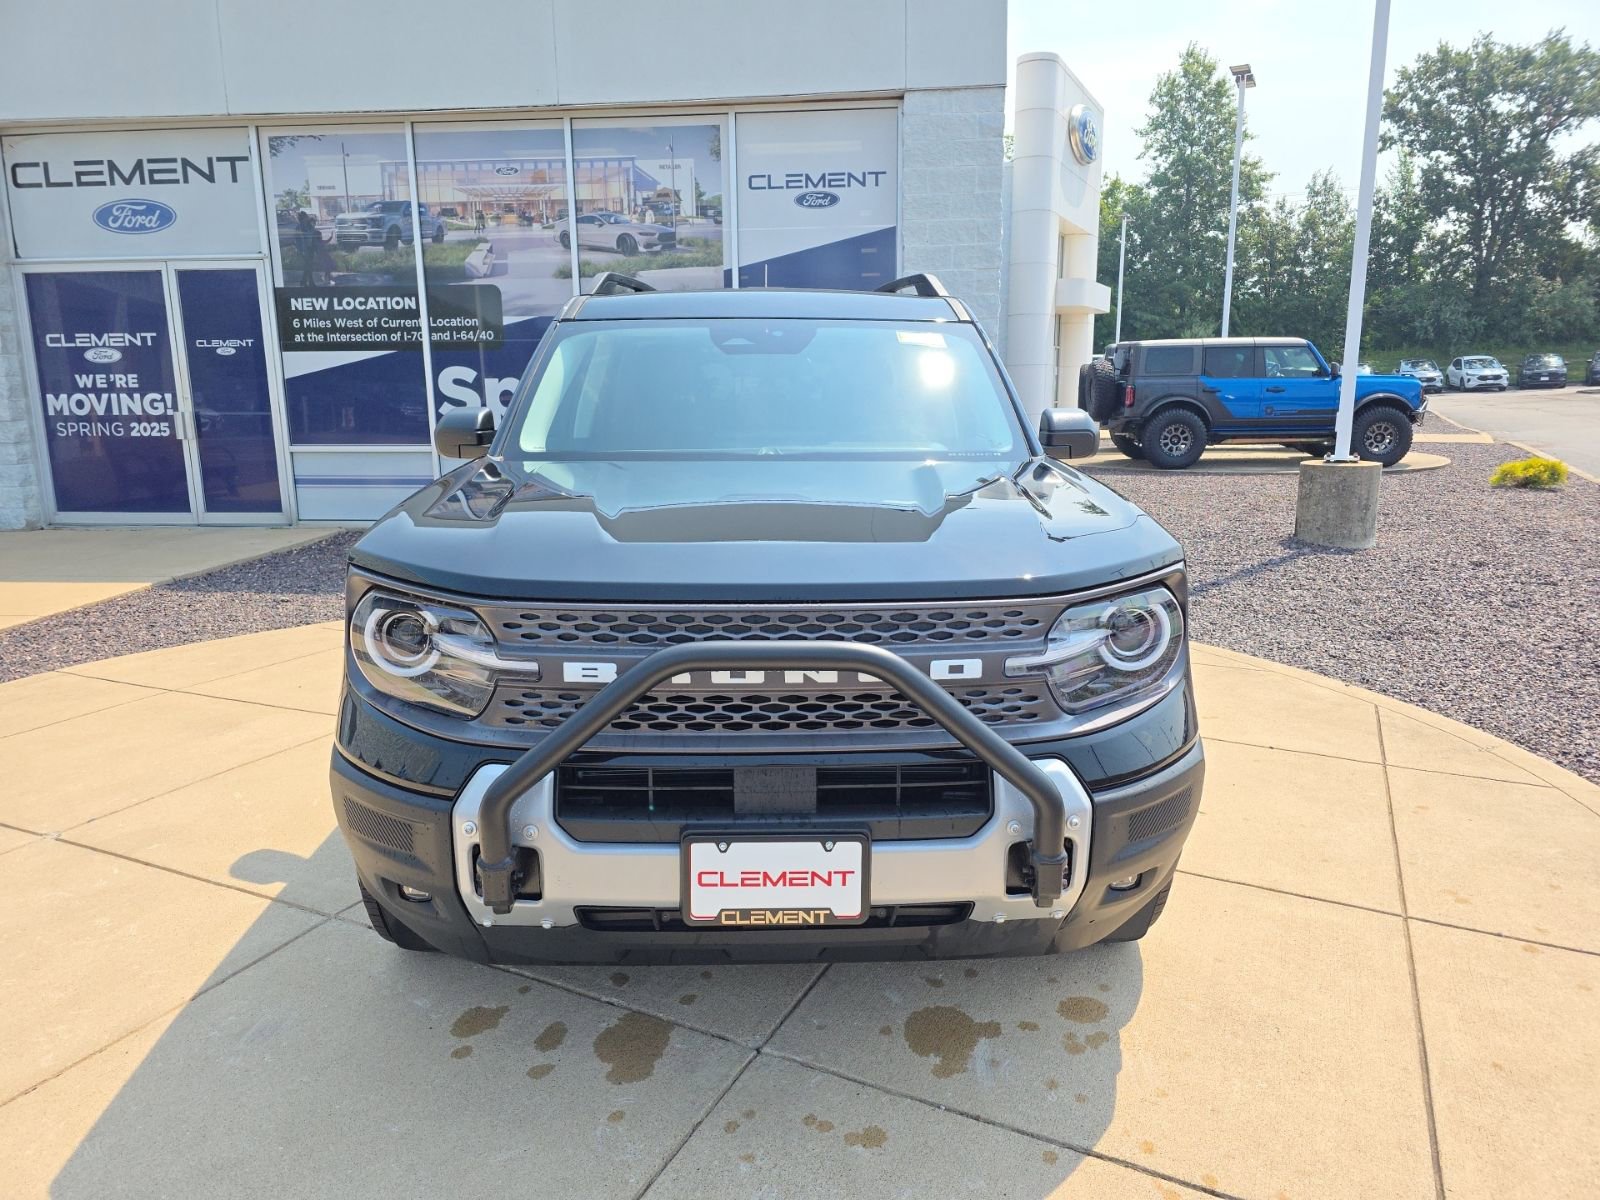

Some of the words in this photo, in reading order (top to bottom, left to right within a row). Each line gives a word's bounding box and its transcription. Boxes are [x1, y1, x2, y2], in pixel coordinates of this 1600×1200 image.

[11, 156, 249, 189] CLEMENT
[748, 171, 887, 190] CLEMENT
[803, 193, 831, 206] Ford
[107, 204, 161, 229] Ford
[290, 298, 329, 311] NEW
[334, 297, 416, 310] LOCATION
[292, 319, 300, 328] 6
[303, 318, 331, 328] Miles
[334, 318, 363, 328] West
[366, 317, 378, 327] of
[381, 317, 421, 327] Current
[430, 316, 479, 327] Location
[45, 332, 157, 348] CLEMENT
[195, 339, 255, 348] CLEMENT
[294, 332, 304, 342] at
[307, 332, 323, 342] the
[327, 331, 388, 342] Intersection
[390, 331, 402, 341] of
[403, 331, 423, 341] I-70
[431, 331, 450, 340] and
[453, 330, 494, 341] I-64/40
[46, 393, 174, 416] MOVING!
[56, 422, 124, 437] SPRING
[130, 422, 171, 437] 2025
[697, 871, 855, 888] CLEMENT
[721, 909, 831, 925] CLEMENT
